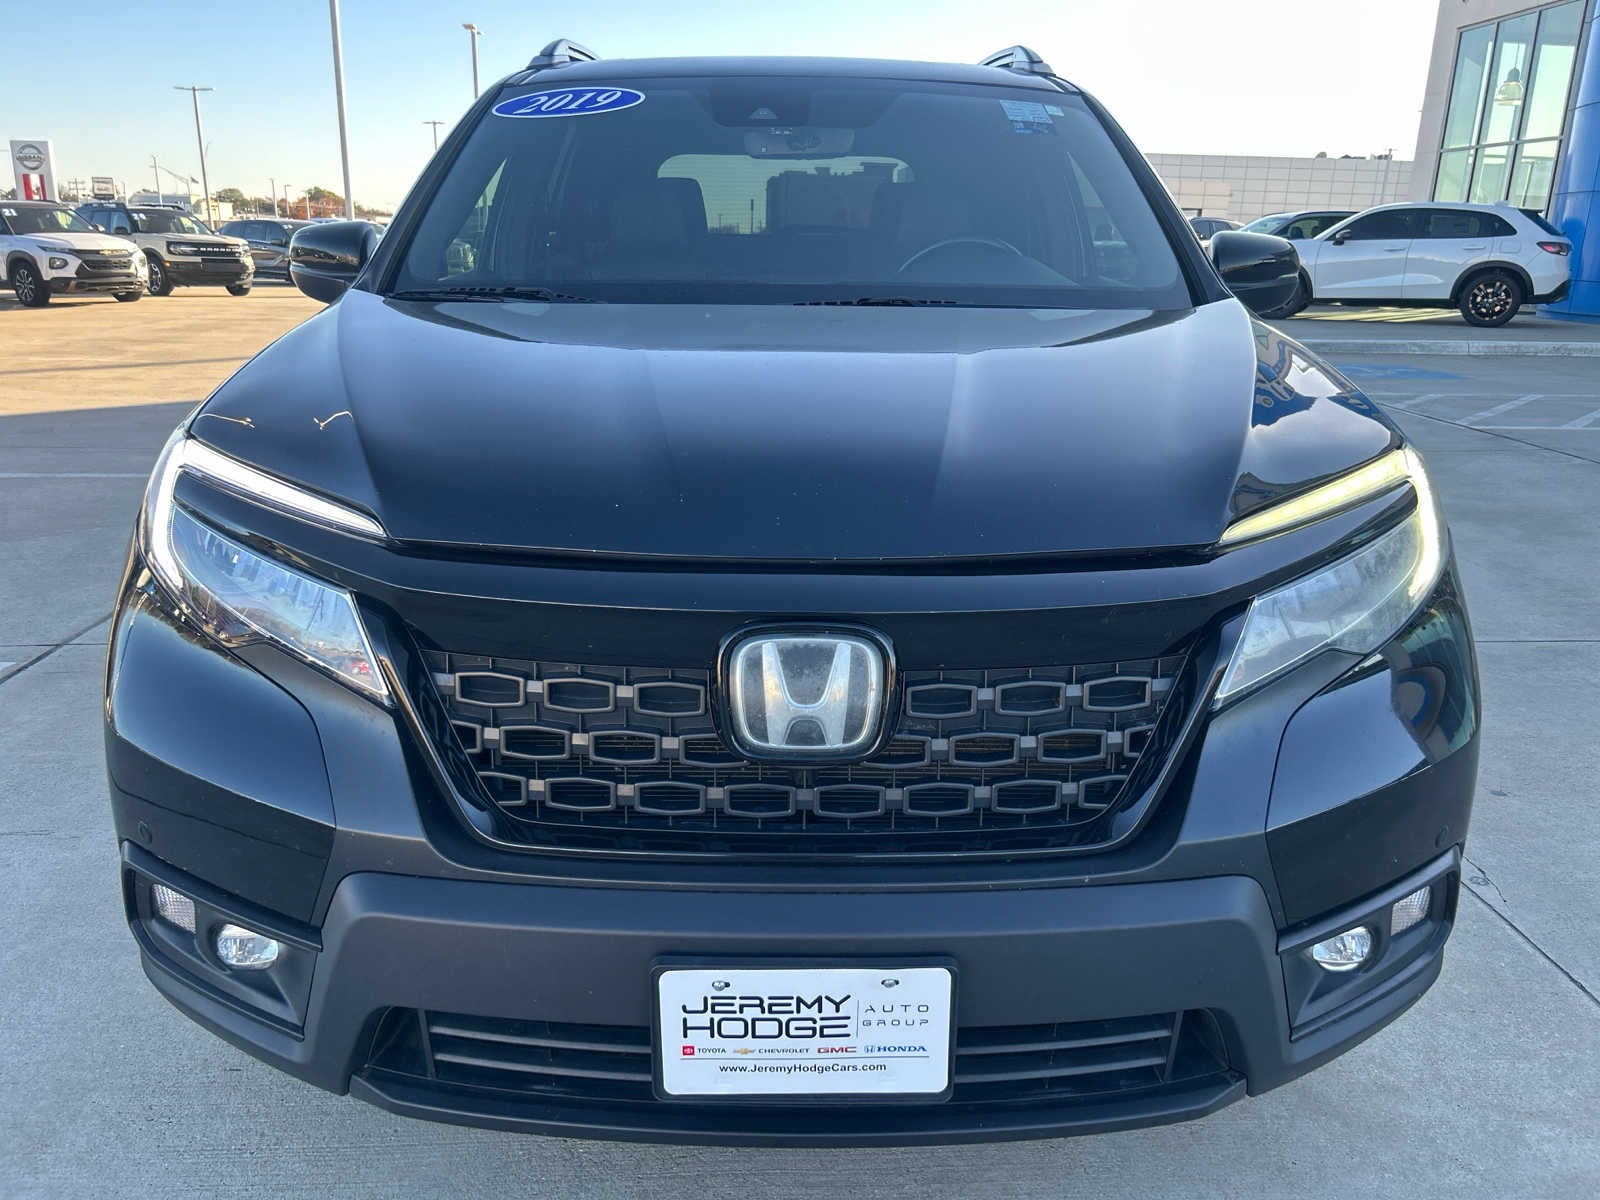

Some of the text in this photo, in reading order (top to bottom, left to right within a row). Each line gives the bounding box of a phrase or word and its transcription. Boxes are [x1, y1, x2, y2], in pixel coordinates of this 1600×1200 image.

[513, 90, 622, 114] 2019
[682, 995, 851, 1014] JEREMY
[864, 1004, 928, 1013] AUTO
[682, 1016, 851, 1039] HODGE
[817, 1046, 857, 1054] GMC
[877, 1045, 927, 1053] HONDA
[719, 1063, 887, 1075] www.JeremyHodgeCars.com
